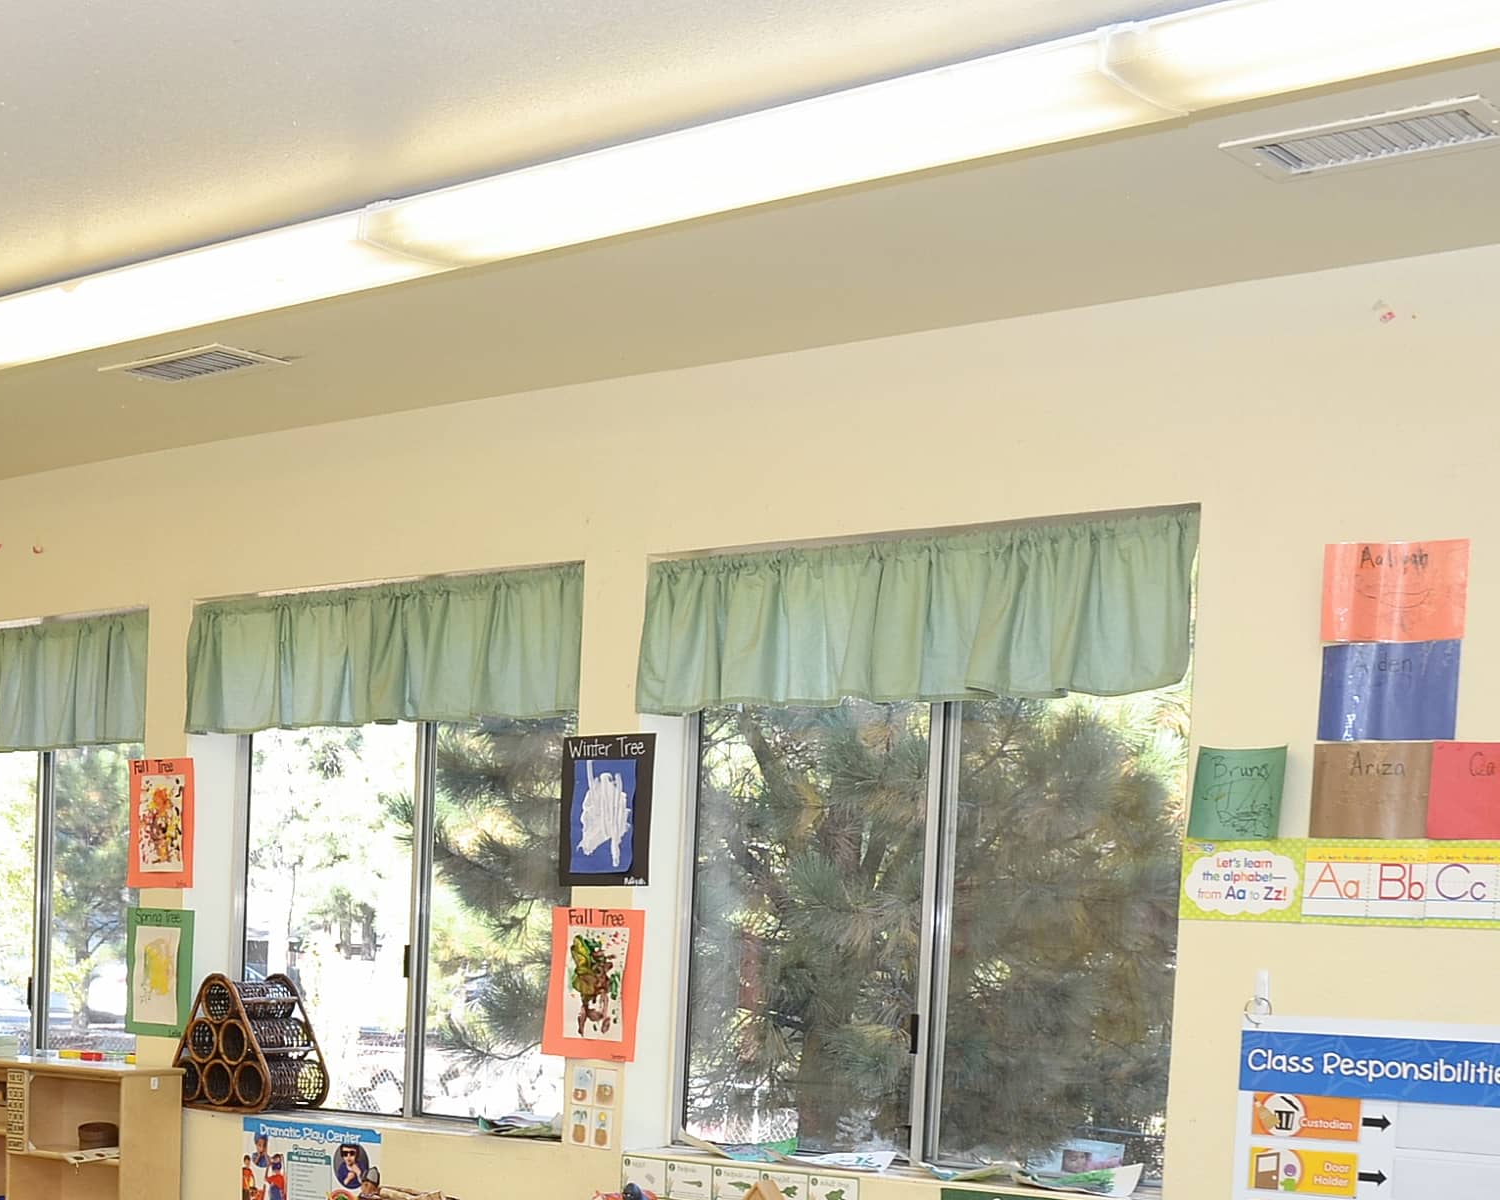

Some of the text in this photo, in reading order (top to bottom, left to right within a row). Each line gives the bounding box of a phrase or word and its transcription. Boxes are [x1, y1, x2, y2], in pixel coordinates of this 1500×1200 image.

[568, 735, 646, 759] Winter Tree
[133, 759, 175, 775] Fall Tree
[1349, 751, 1406, 777] Ariza
[1216, 857, 1273, 869] Let's learn
[1202, 870, 1220, 882] the
[1308, 862, 1487, 901] Aa Bb Cc
[1197, 885, 1288, 901] from Aa to Zz!
[134, 909, 182, 925] Spring Tree
[567, 908, 625, 926] Fall Tree
[1247, 1048, 1315, 1075] Class
[1299, 1116, 1353, 1131] Custodian
[259, 1123, 362, 1144] Dramatic Play Center
[292, 1144, 326, 1157] Preschool
[1323, 1162, 1351, 1174] Door
[1313, 1174, 1350, 1188] Holder
